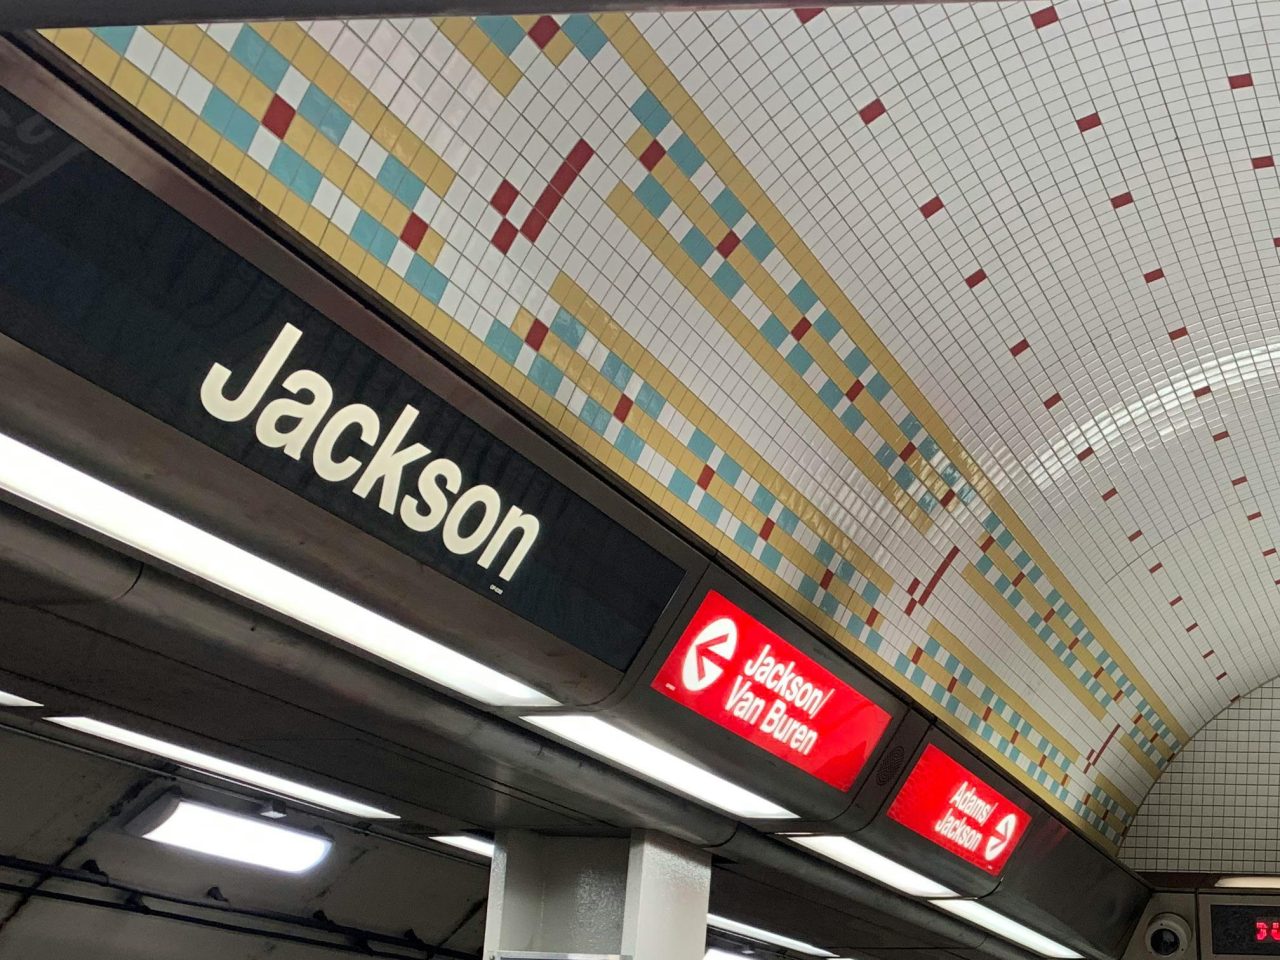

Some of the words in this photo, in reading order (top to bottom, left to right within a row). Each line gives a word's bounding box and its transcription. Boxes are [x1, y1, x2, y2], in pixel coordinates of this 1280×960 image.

[200, 322, 540, 581] Jackson
[724, 675, 762, 727] Van
[761, 704, 818, 756] Buren
[744, 644, 835, 719] Jackson/
[935, 808, 982, 854] Jackson
[949, 781, 996, 827] Adams/
